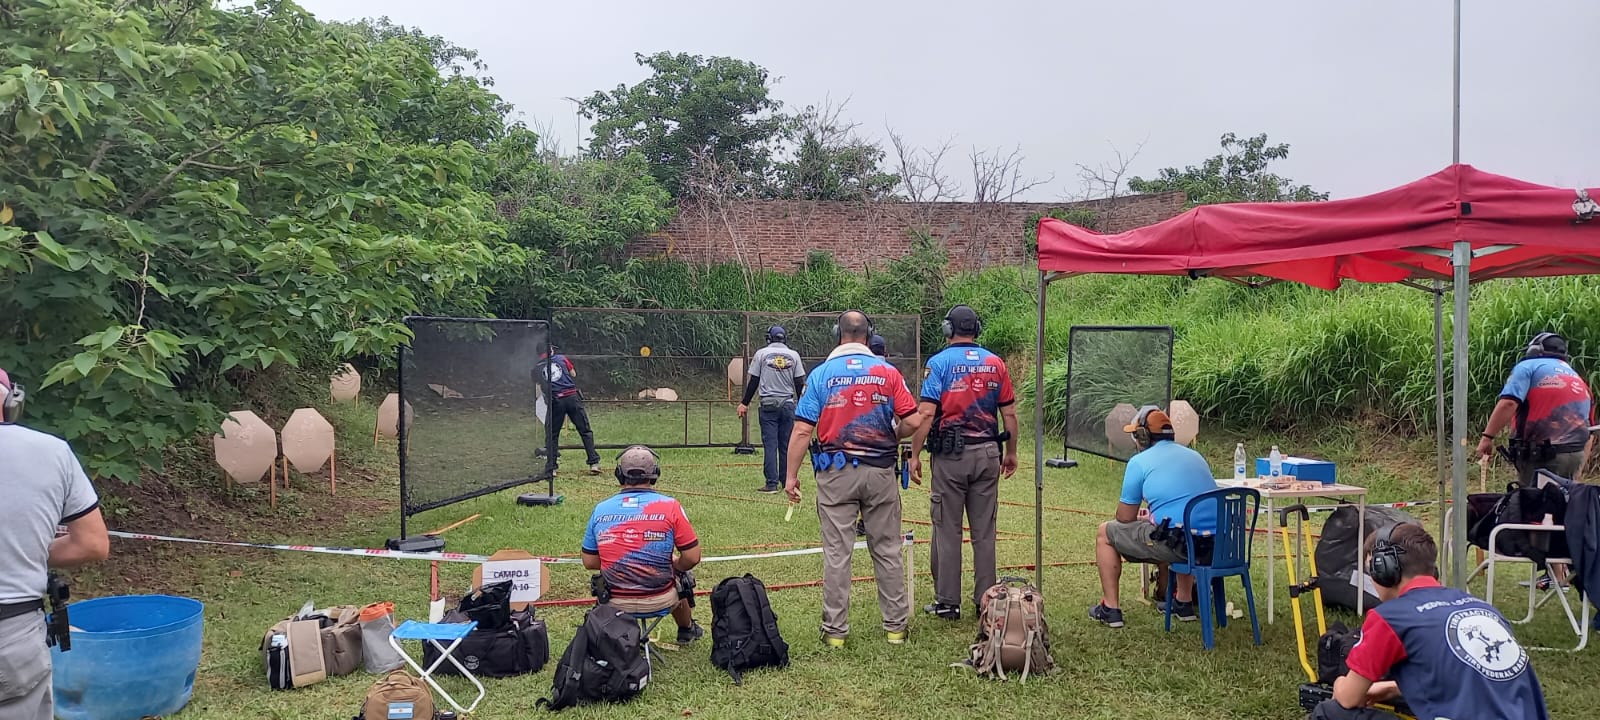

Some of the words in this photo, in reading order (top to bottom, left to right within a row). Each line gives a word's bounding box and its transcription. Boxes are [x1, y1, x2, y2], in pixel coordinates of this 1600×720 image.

[493, 570, 522, 579] CAMPO
[520, 583, 529, 591] 10
[1464, 654, 1481, 671] TIRO
[1481, 668, 1514, 679] FEDERAL
